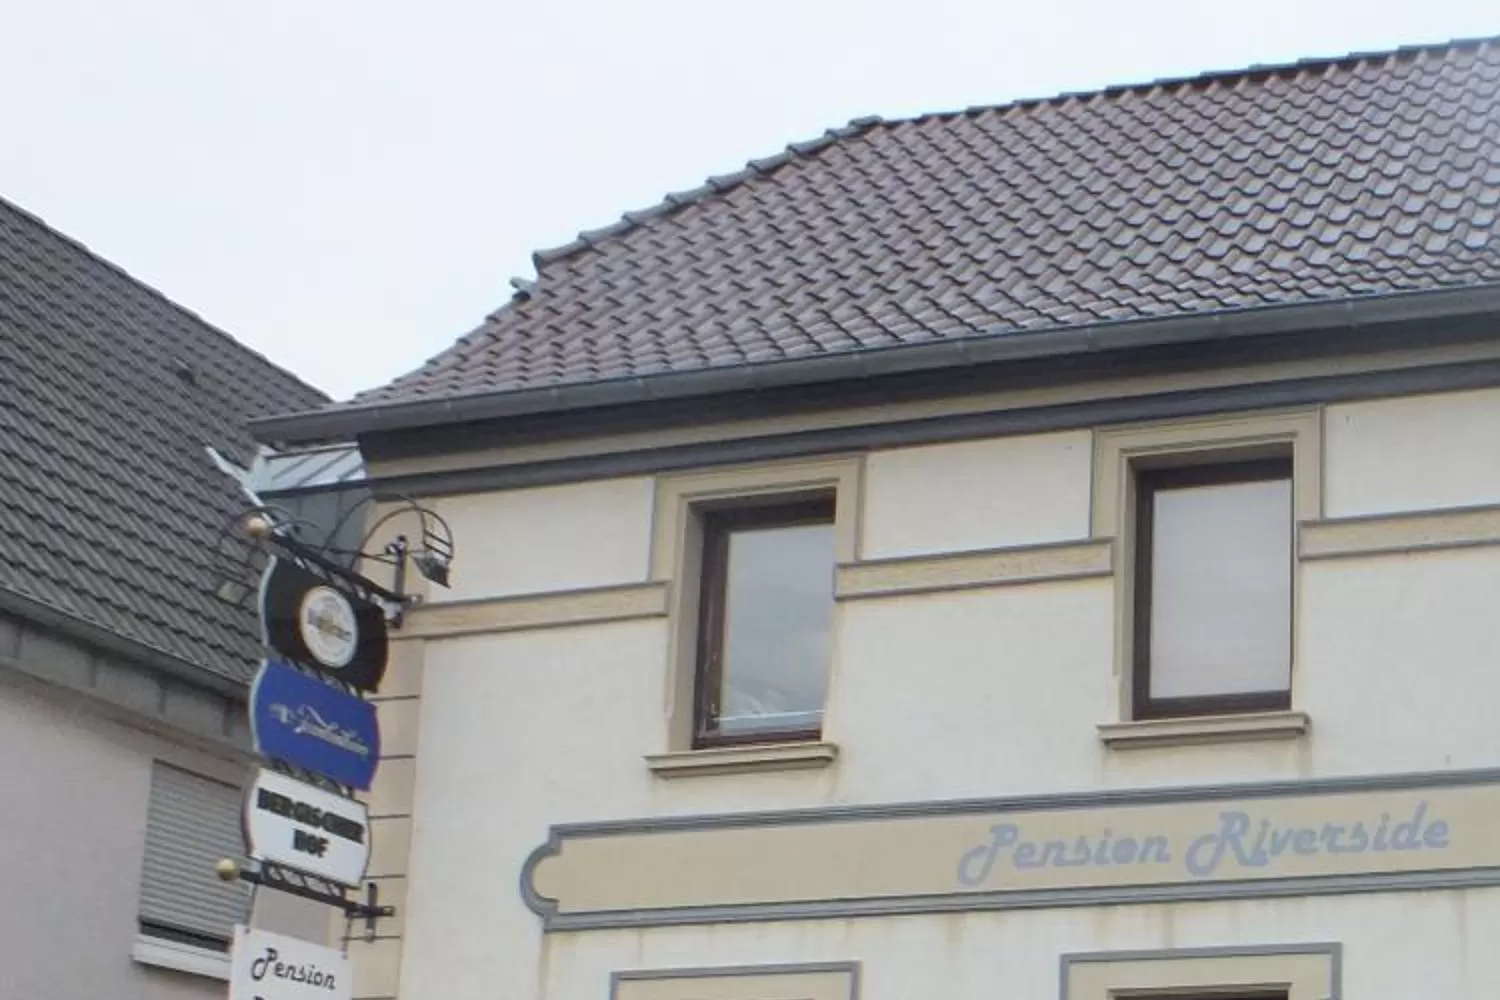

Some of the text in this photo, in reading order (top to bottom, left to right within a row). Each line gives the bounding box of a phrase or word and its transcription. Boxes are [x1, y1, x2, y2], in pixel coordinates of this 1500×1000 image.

[957, 801, 1452, 887] Pension Riverside
[250, 946, 336, 990] Pension
